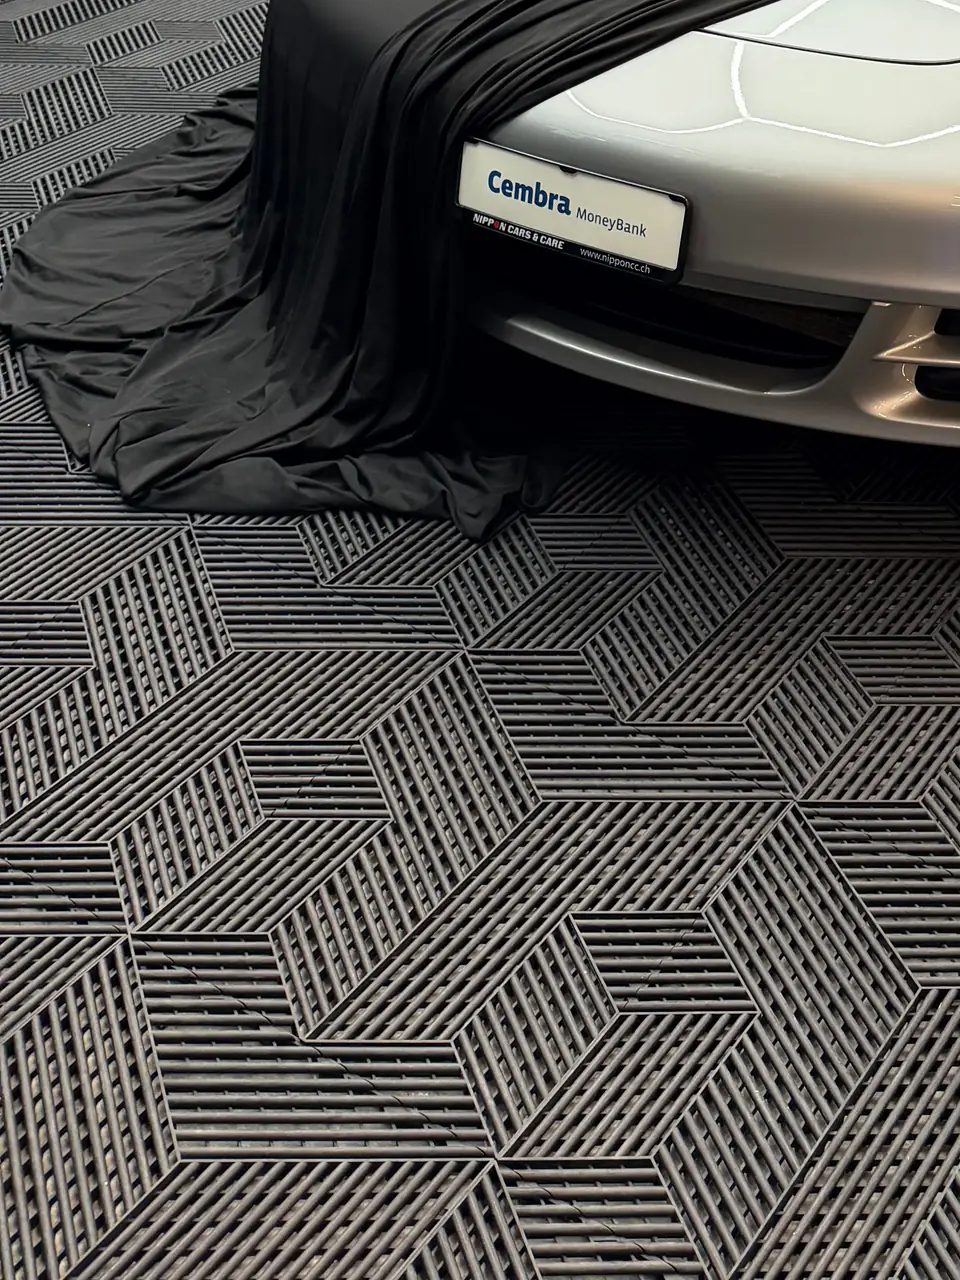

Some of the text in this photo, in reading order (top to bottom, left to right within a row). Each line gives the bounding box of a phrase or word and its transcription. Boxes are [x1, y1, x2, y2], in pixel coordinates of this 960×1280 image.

[487, 170, 647, 238] Cembra MoneyBank
[472, 213, 565, 250] NIPPON CARS & CARE
[580, 248, 651, 274] www.nipponcc.ch
